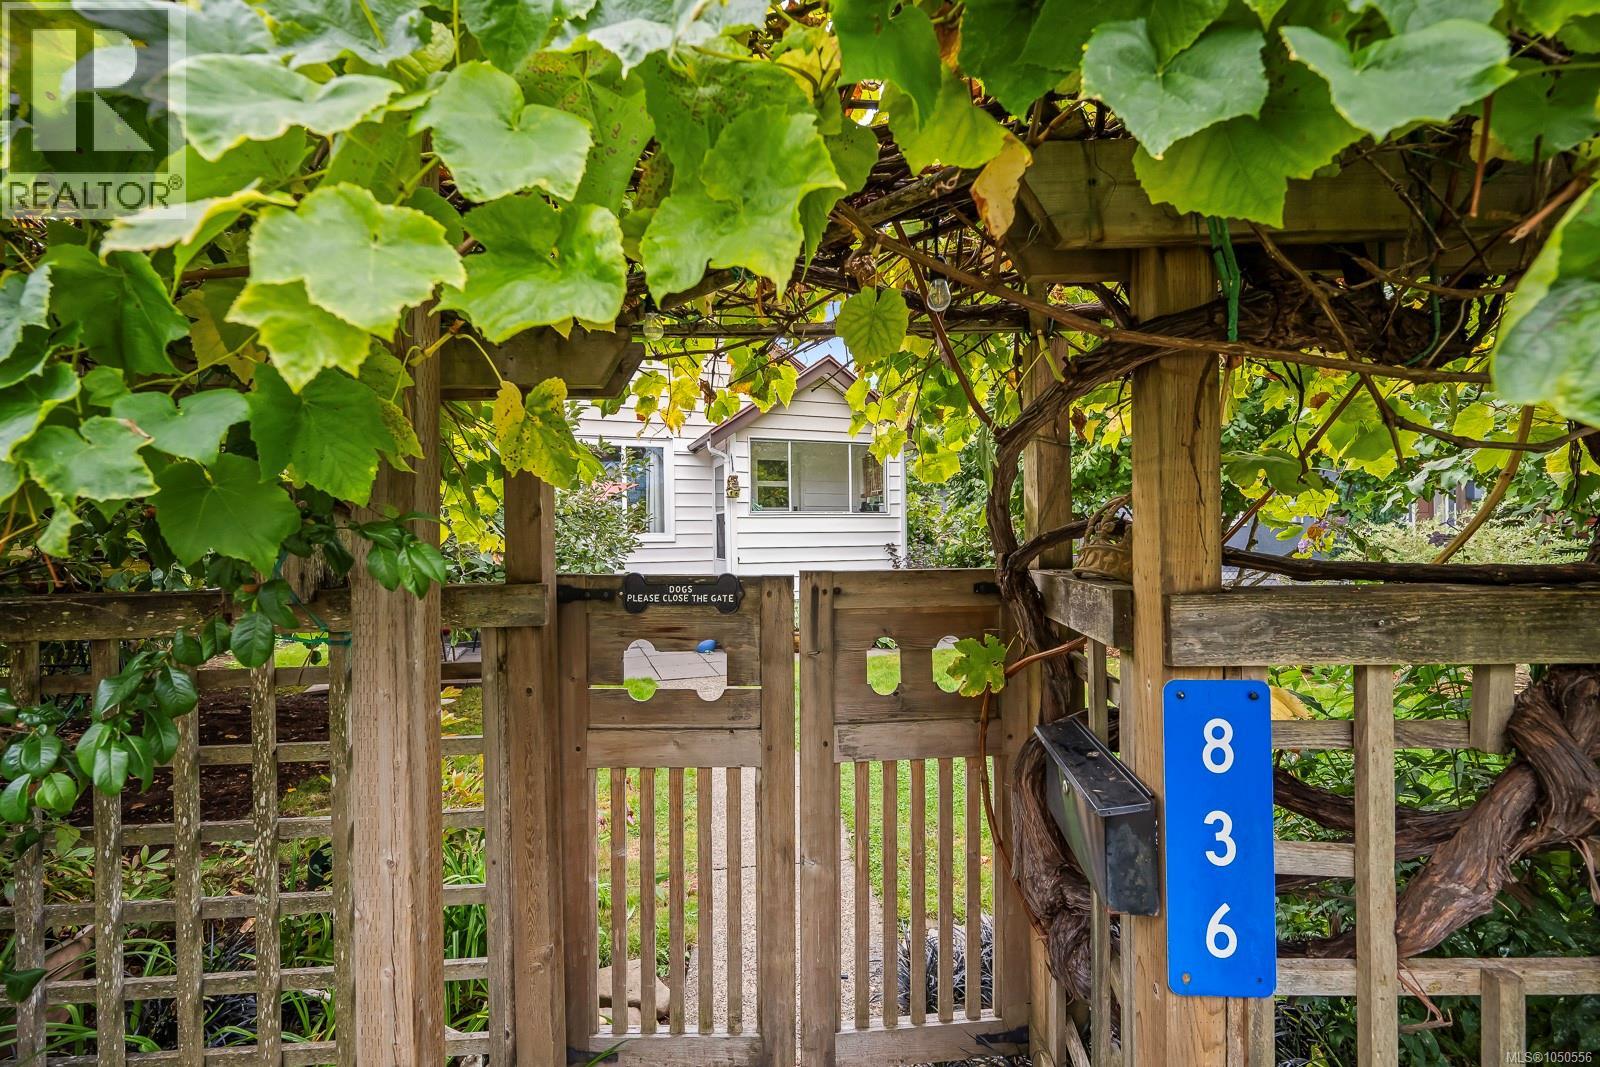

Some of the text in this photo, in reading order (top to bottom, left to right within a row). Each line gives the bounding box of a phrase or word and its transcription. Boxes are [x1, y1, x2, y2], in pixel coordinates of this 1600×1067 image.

[669, 585, 693, 593] DOGS
[626, 594, 734, 603] PLEASE CLOSE THE GATE
